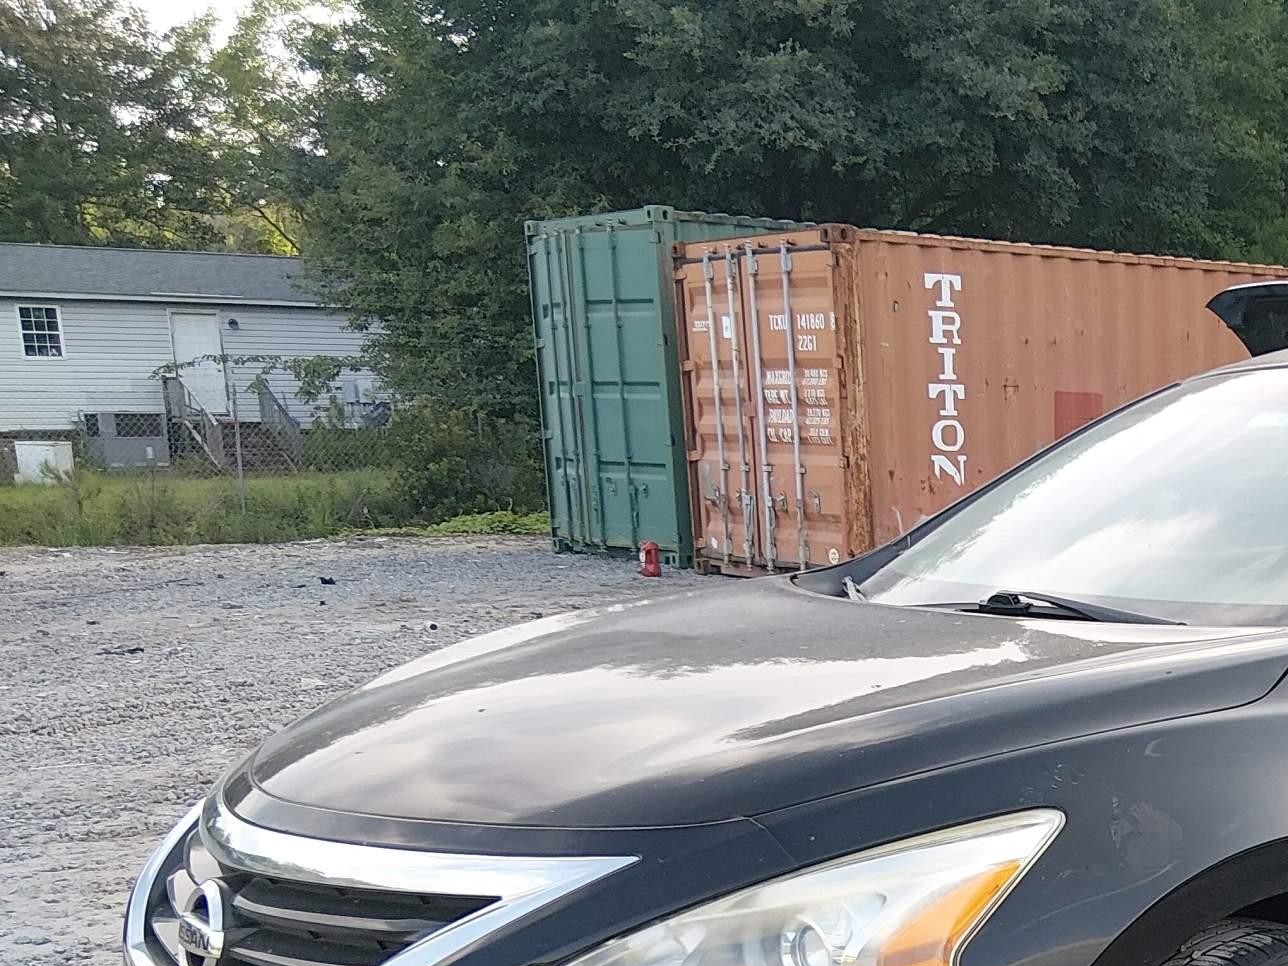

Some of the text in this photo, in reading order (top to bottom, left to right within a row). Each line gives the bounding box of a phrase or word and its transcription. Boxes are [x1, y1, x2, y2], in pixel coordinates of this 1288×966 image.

[768, 314, 788, 331] TCKU
[796, 313, 825, 330] 141860
[924, 272, 965, 486] TRITON
